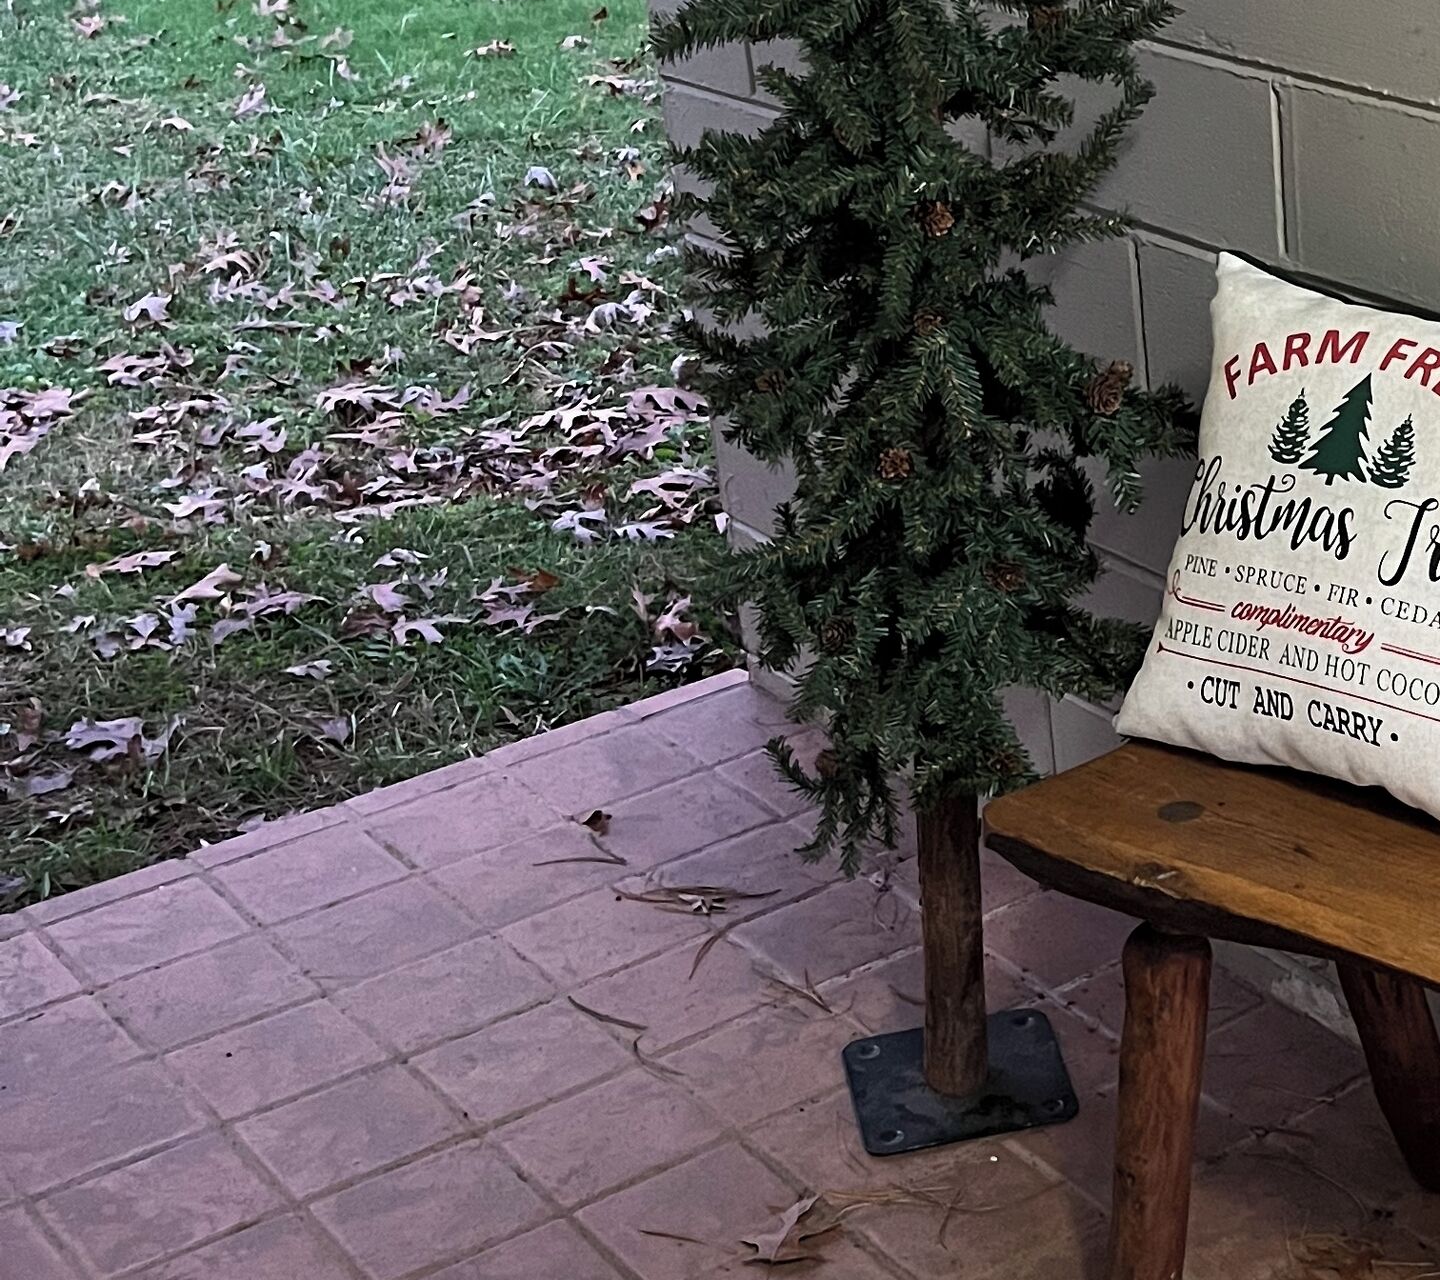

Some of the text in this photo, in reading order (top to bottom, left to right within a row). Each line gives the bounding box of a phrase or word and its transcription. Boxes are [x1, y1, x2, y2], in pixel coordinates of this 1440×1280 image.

[1223, 329, 1371, 401] FARM
[1180, 455, 1358, 561] Christmas
[1184, 553, 1218, 578] PINE
[1234, 564, 1308, 595] SPRUCE
[1326, 583, 1360, 608] FIR
[1164, 616, 1213, 649] APPLE
[1217, 629, 1271, 661] CIDER
[1278, 642, 1319, 672] AND
[1324, 653, 1371, 686] HOT
[1230, 601, 1375, 655] complimentary
[1200, 675, 1384, 748] CUT AND CARRY
